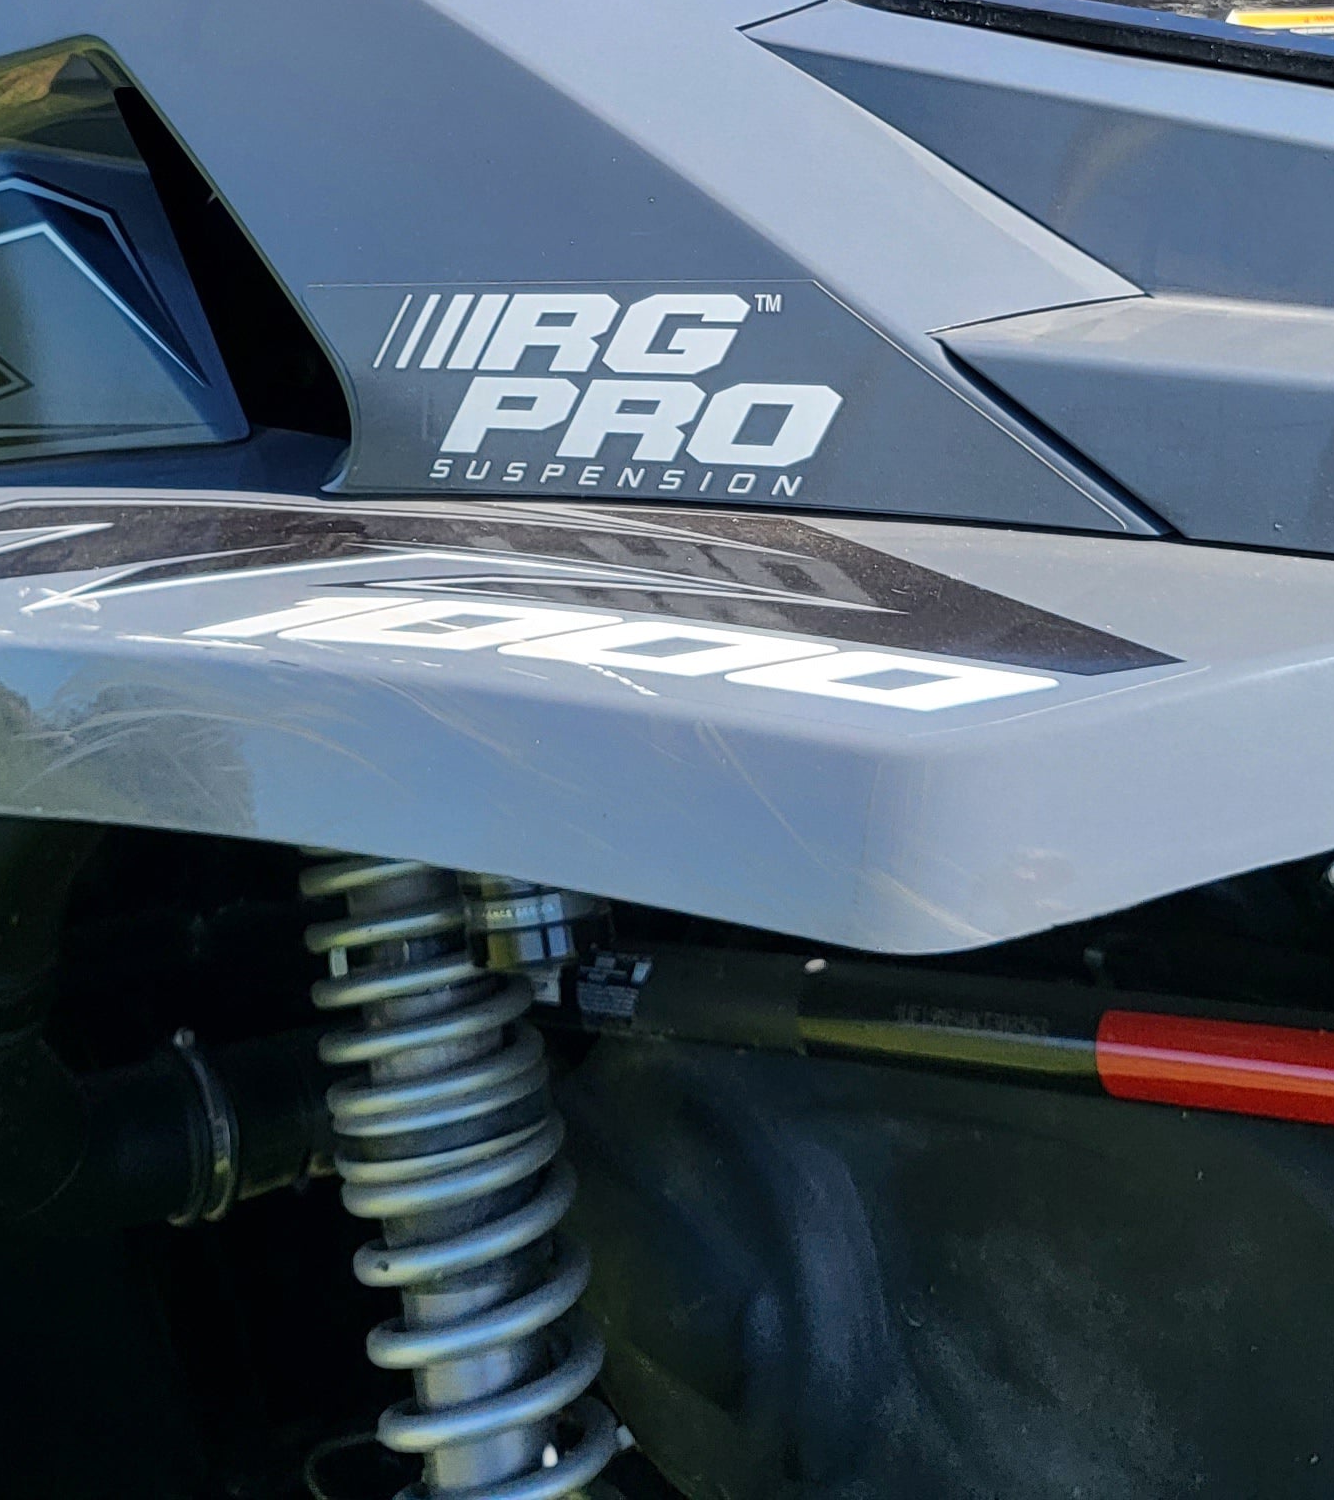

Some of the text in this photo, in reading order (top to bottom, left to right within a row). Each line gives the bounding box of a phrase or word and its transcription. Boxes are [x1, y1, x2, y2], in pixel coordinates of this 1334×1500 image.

[439, 376, 844, 467] PRO
[429, 458, 803, 497] SUSPENSION
[183, 596, 1061, 712] 1000
